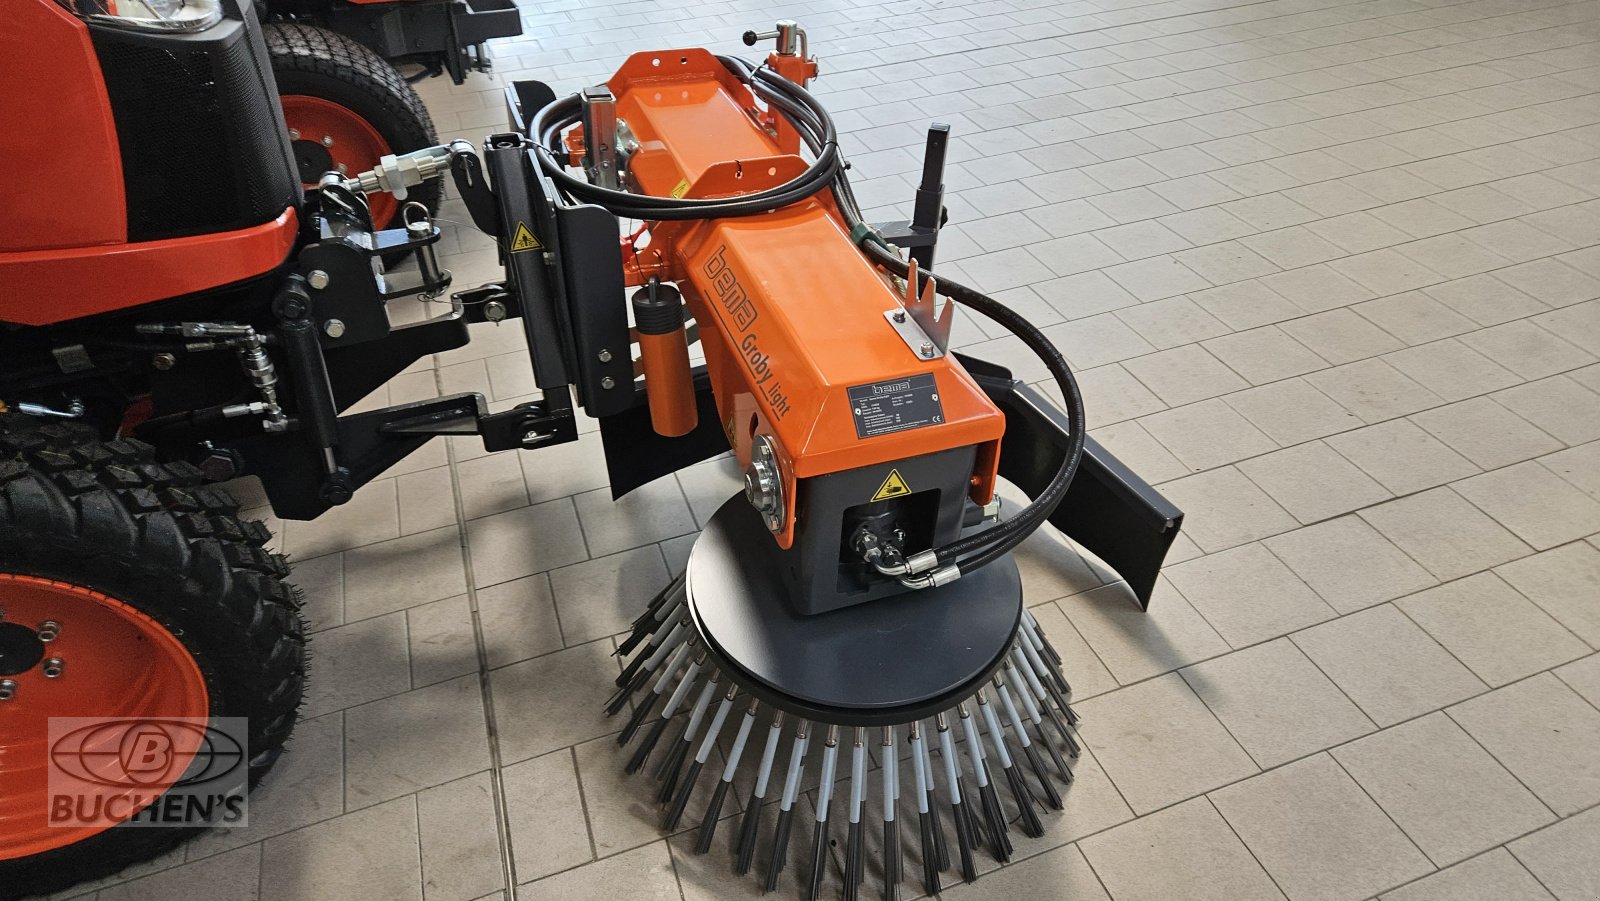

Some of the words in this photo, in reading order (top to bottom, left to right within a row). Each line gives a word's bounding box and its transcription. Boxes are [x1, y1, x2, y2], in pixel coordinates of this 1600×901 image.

[703, 244, 758, 333] bema
[741, 333, 774, 385] Groby
[767, 382, 791, 417] light
[872, 382, 911, 396] bema
